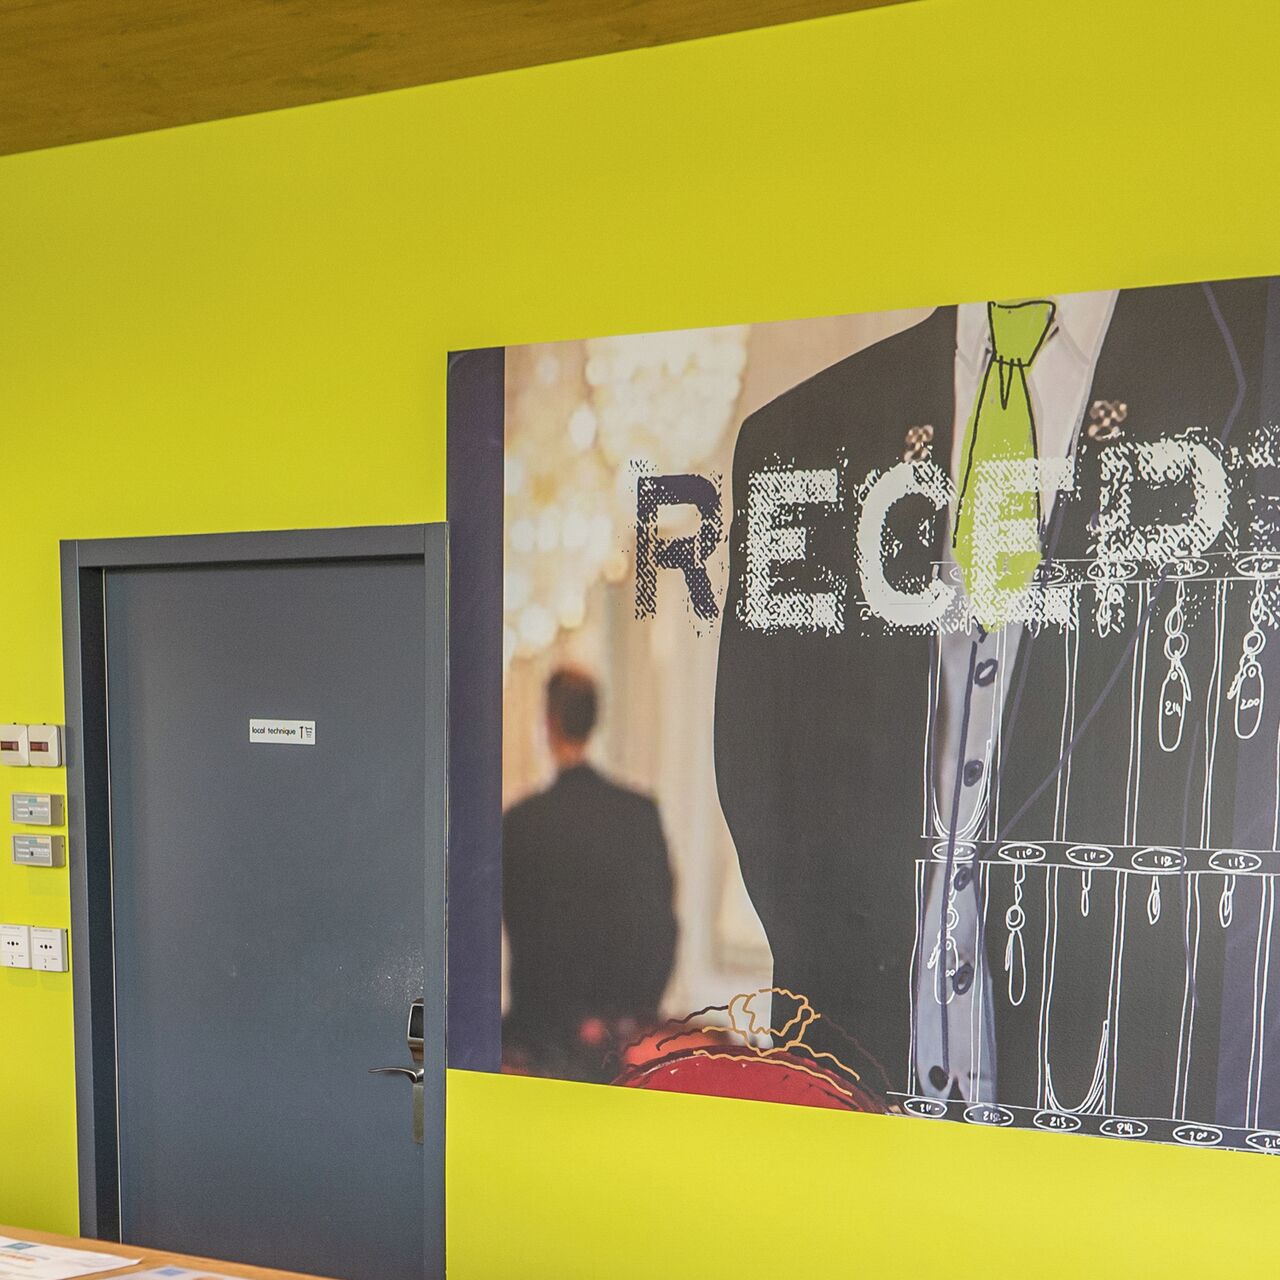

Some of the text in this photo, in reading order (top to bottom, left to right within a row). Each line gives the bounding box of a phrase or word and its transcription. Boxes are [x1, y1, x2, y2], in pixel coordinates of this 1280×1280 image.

[1165, 700, 1182, 717] 214
[1240, 698, 1260, 710] 200
[268, 728, 296, 736] technique
[1016, 848, 1032, 858] 110
[1084, 852, 1096, 861] 111
[1050, 1117, 1067, 1128] 213
[1116, 1122, 1134, 1136] 214
